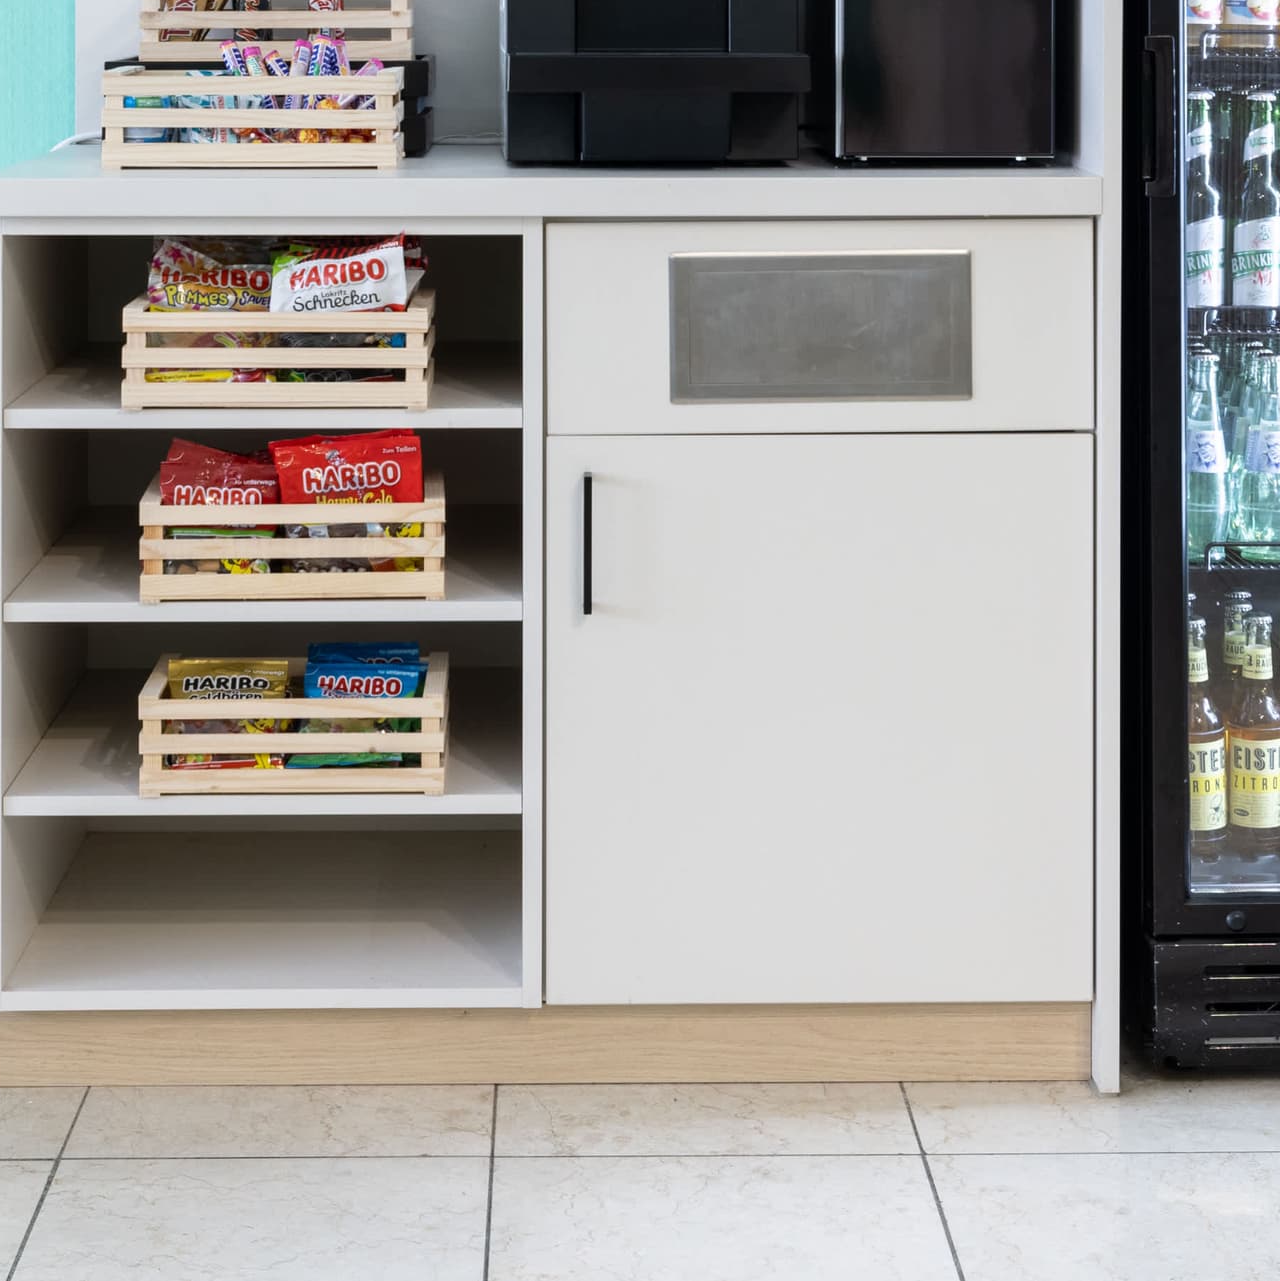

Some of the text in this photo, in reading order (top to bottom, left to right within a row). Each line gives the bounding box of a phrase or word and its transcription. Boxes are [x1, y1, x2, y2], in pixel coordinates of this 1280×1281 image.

[289, 257, 385, 291] HARIBO
[239, 292, 270, 307] SAUE
[292, 289, 381, 313] Schnecken
[321, 288, 348, 298] Lakritz
[395, 445, 417, 454] Teilen
[302, 460, 401, 494] HARIBO
[173, 484, 263, 505] HARIBO
[1227, 644, 1245, 655] RAUC
[183, 675, 270, 693] HARIBO
[318, 675, 403, 697] HARIBO
